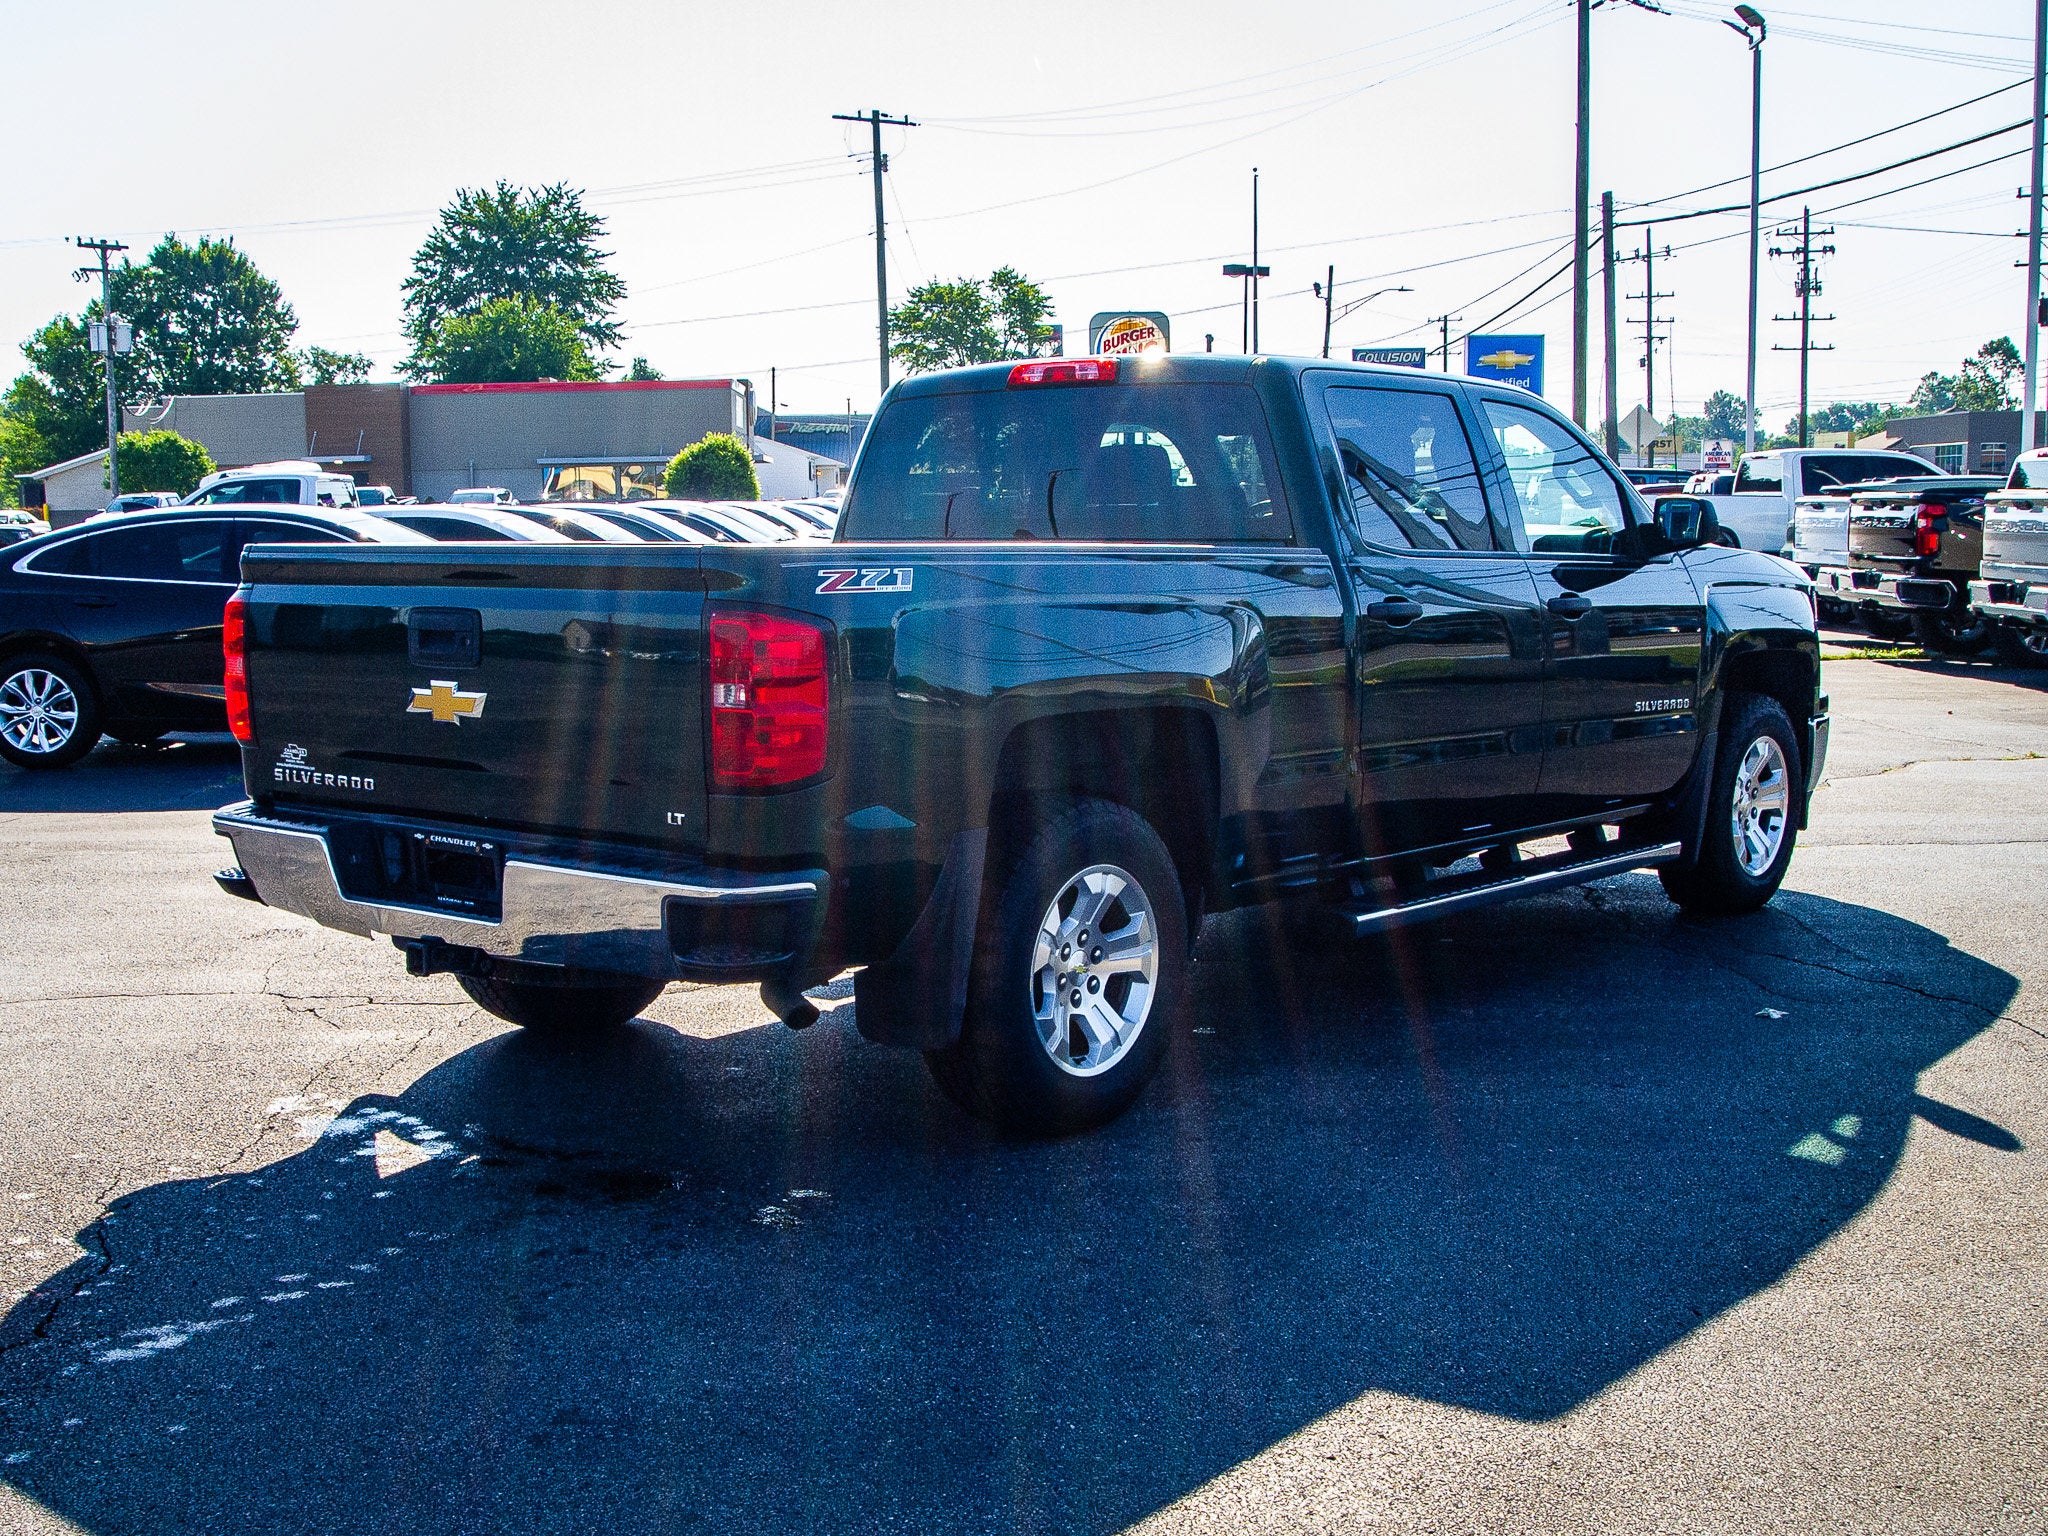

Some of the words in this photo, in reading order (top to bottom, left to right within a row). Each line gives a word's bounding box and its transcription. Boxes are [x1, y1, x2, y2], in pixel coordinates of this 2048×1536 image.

[1103, 326, 1155, 353] BURGER
[1356, 352, 1421, 363] COLLISION
[815, 568, 914, 594] Z71
[1634, 698, 1690, 712] SILVERADO
[274, 768, 374, 790] SILVERADO
[667, 811, 685, 826] LT
[430, 834, 477, 848] CHANDLER
